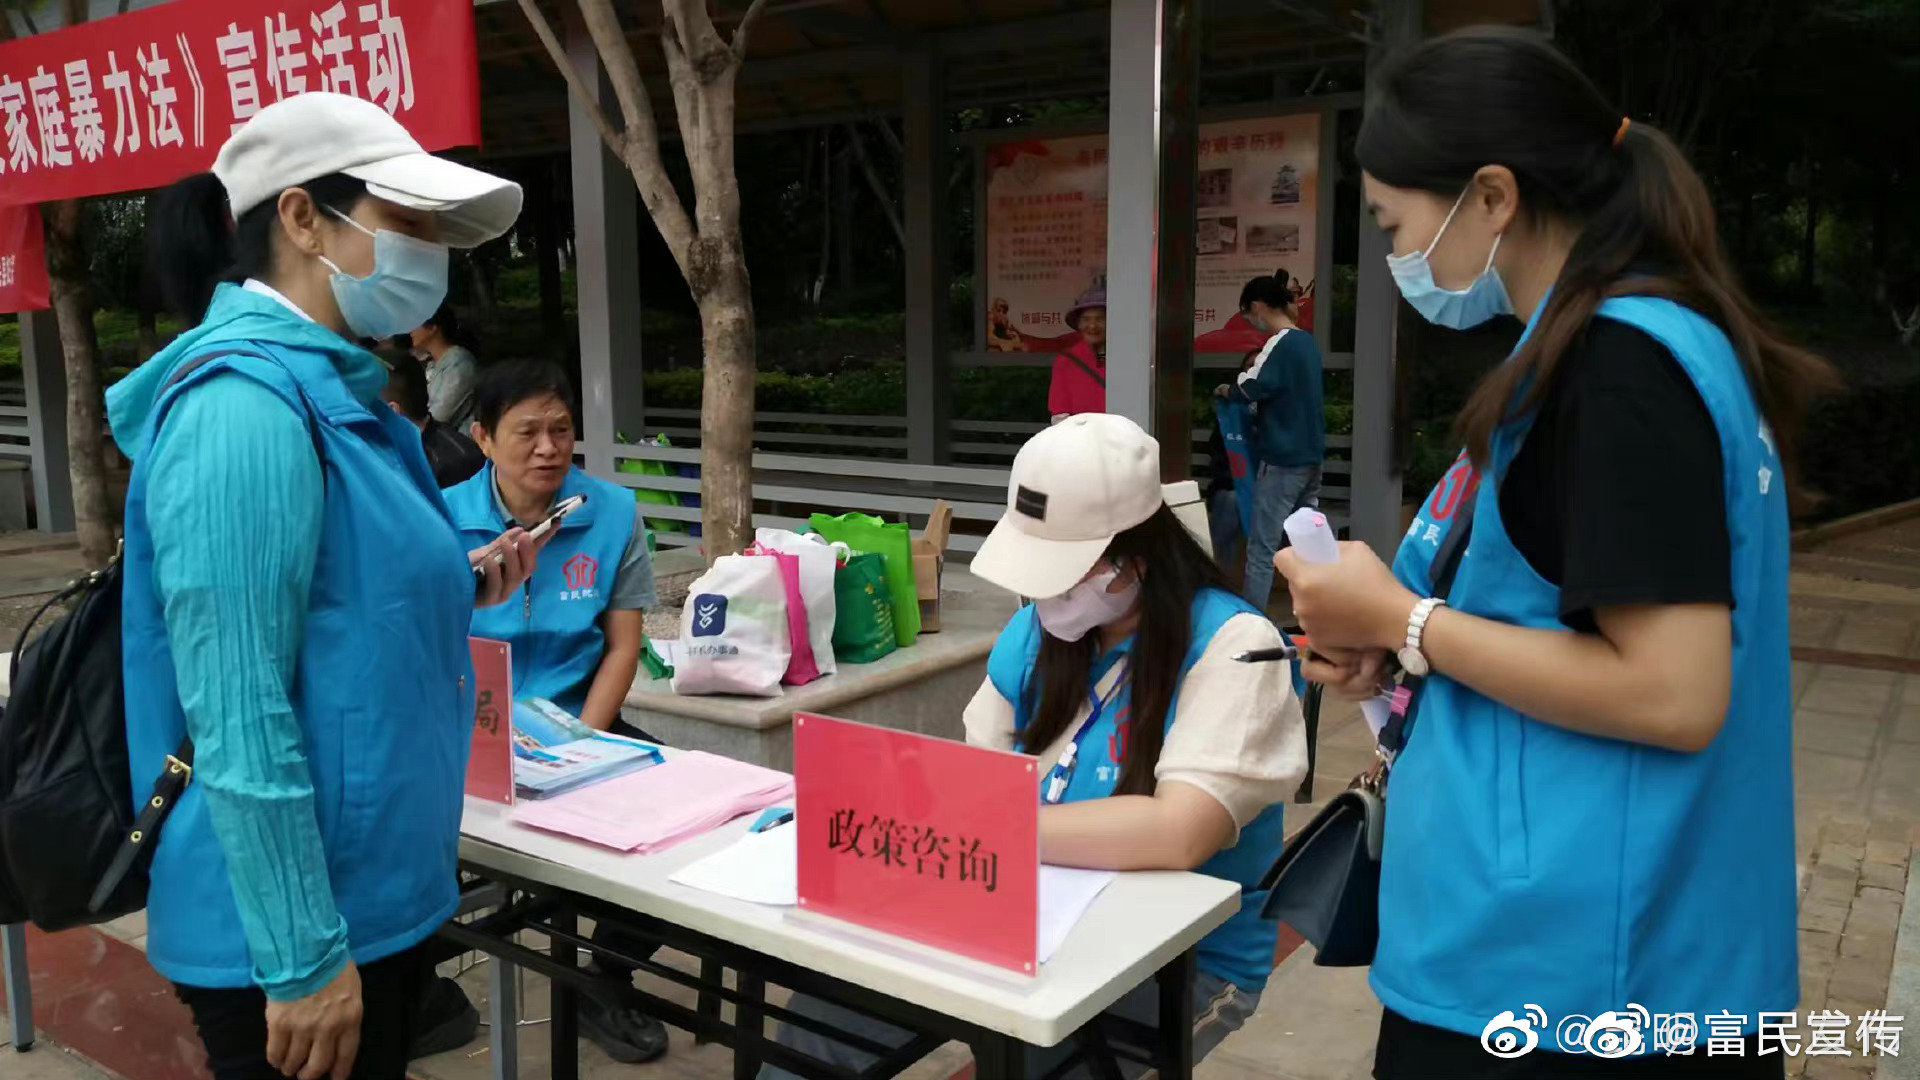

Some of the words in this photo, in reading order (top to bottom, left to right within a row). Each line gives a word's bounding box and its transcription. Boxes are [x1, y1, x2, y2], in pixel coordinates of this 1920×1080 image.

[0, 0, 415, 174] 家庭暴力法》宣传活动
[828, 808, 998, 893] 政策咨询
